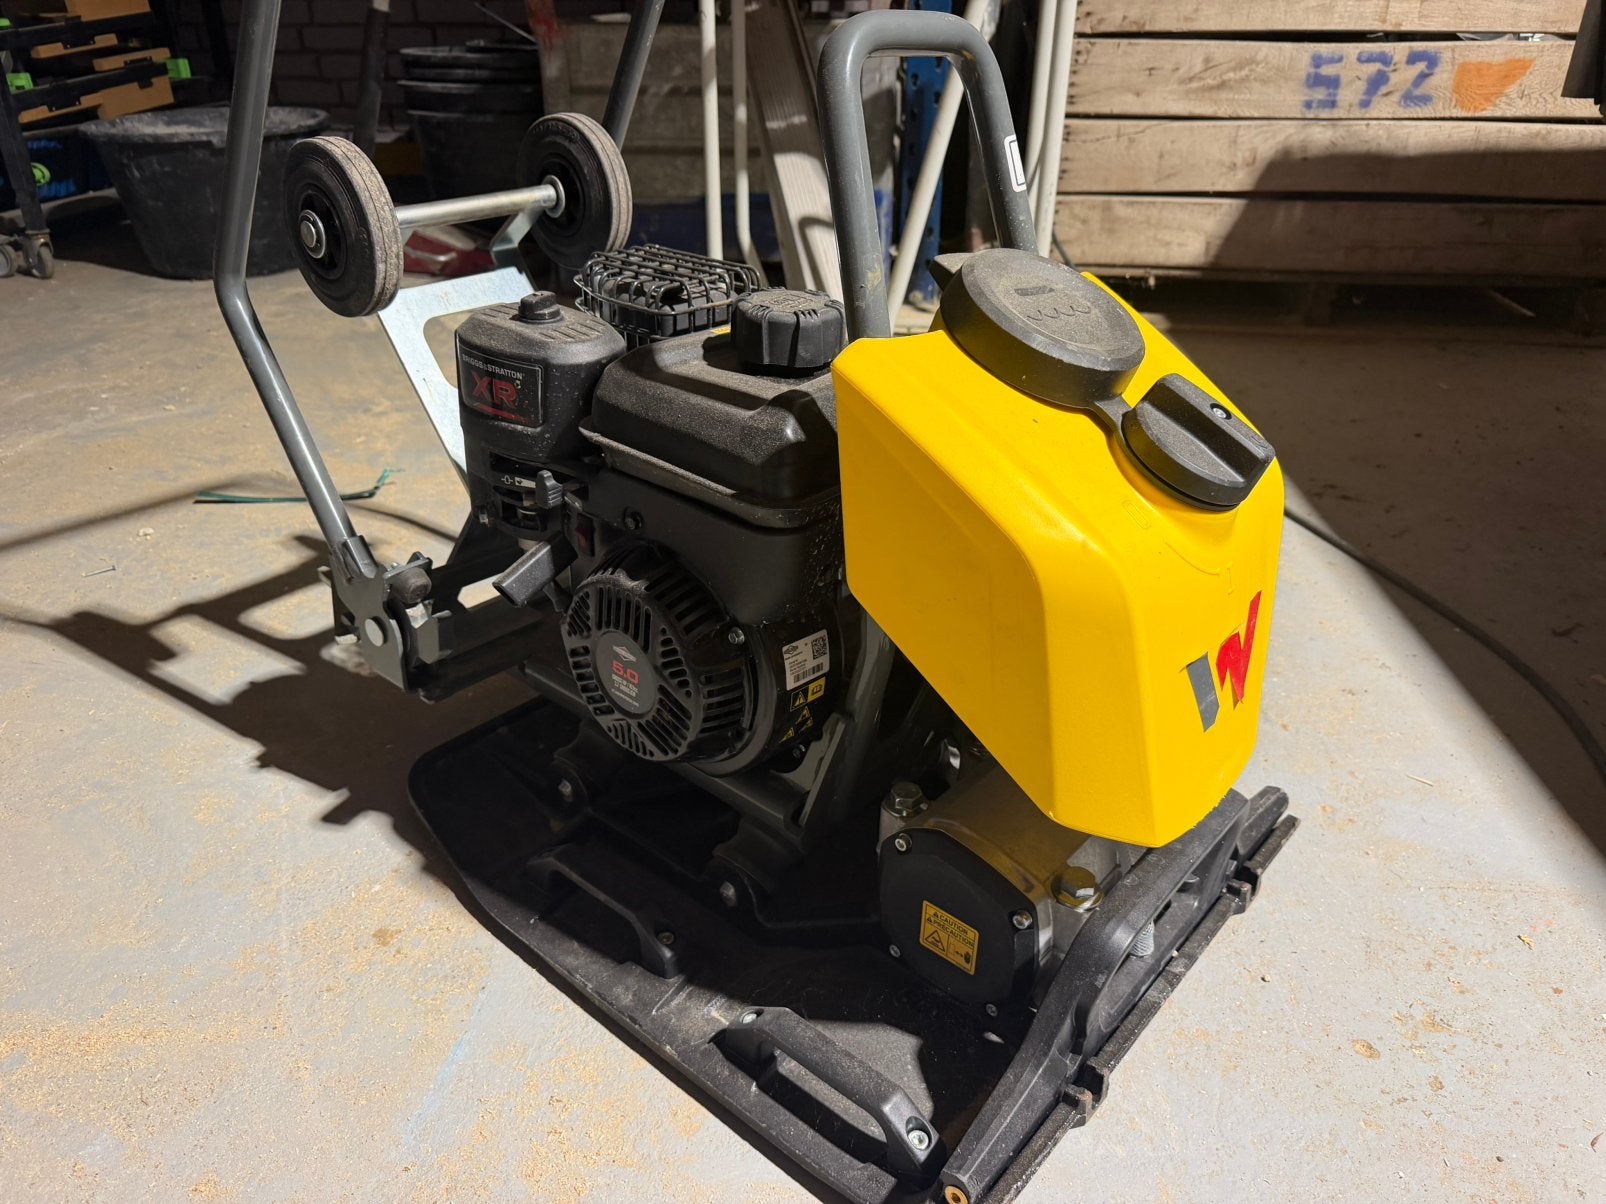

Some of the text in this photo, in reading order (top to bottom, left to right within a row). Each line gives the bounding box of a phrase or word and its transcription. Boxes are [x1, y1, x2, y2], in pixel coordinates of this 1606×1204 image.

[1302, 50, 1442, 110] 572
[471, 370, 518, 410] XR
[612, 659, 640, 685] 5.0
[932, 919, 975, 948] PRECAUTION
[939, 914, 969, 936] CAUTION
